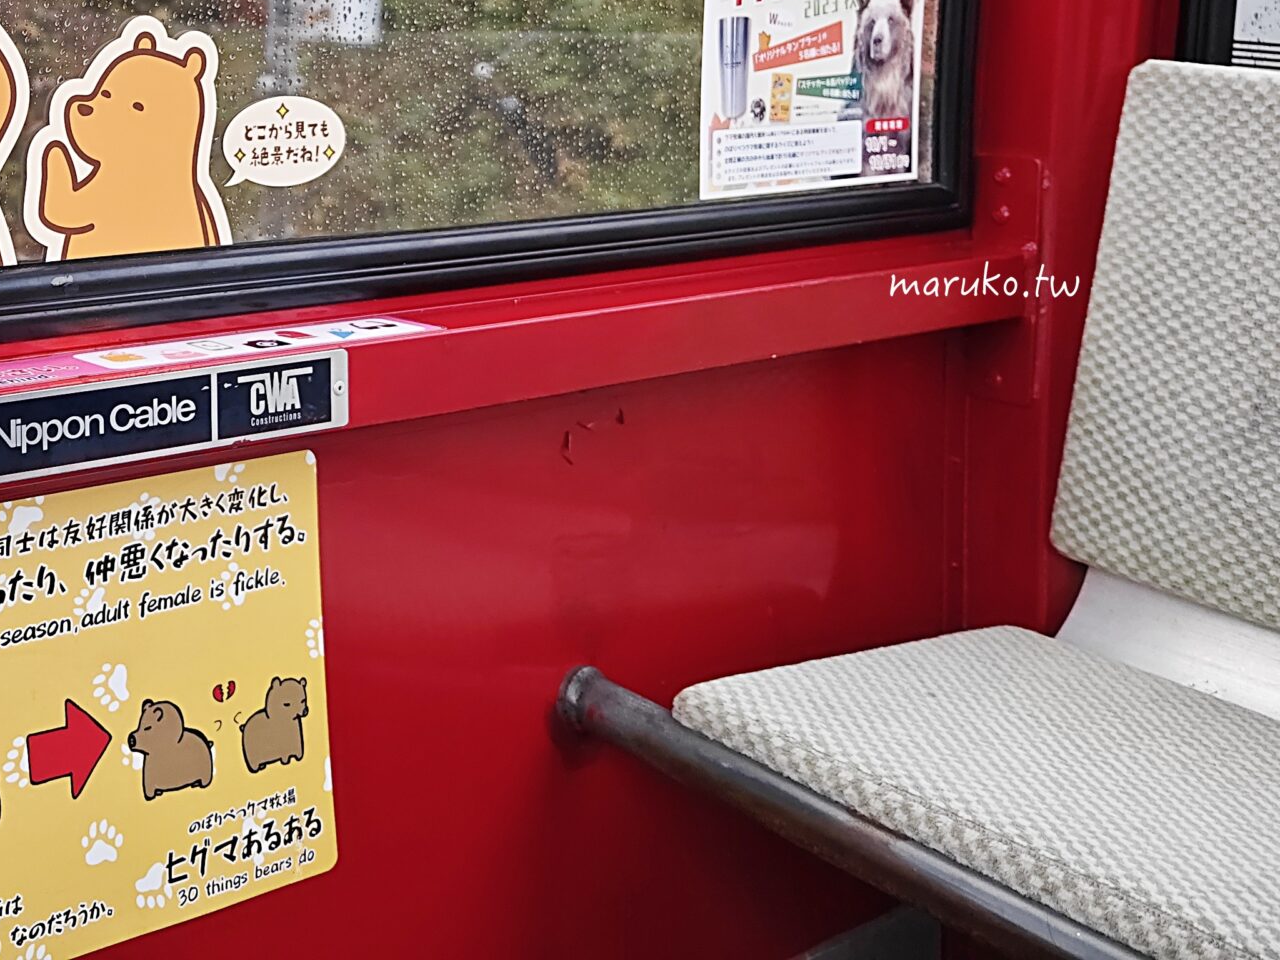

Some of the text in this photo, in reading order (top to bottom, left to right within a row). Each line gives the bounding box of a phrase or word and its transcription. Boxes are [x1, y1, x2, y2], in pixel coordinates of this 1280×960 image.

[244, 121, 329, 141] どこから見ても
[109, 395, 196, 432] Cable
[239, 367, 311, 416] CWA
[250, 411, 302, 427] Constructions
[138, 586, 202, 618] female
[210, 579, 224, 599] is
[232, 568, 285, 596] fickle.
[189, 788, 297, 834] のぼりべつクマ牧場
[166, 807, 322, 884] ヒグマあるある
[178, 848, 315, 907] 30 things bears do
[11, 902, 113, 946] なのだろうか。
